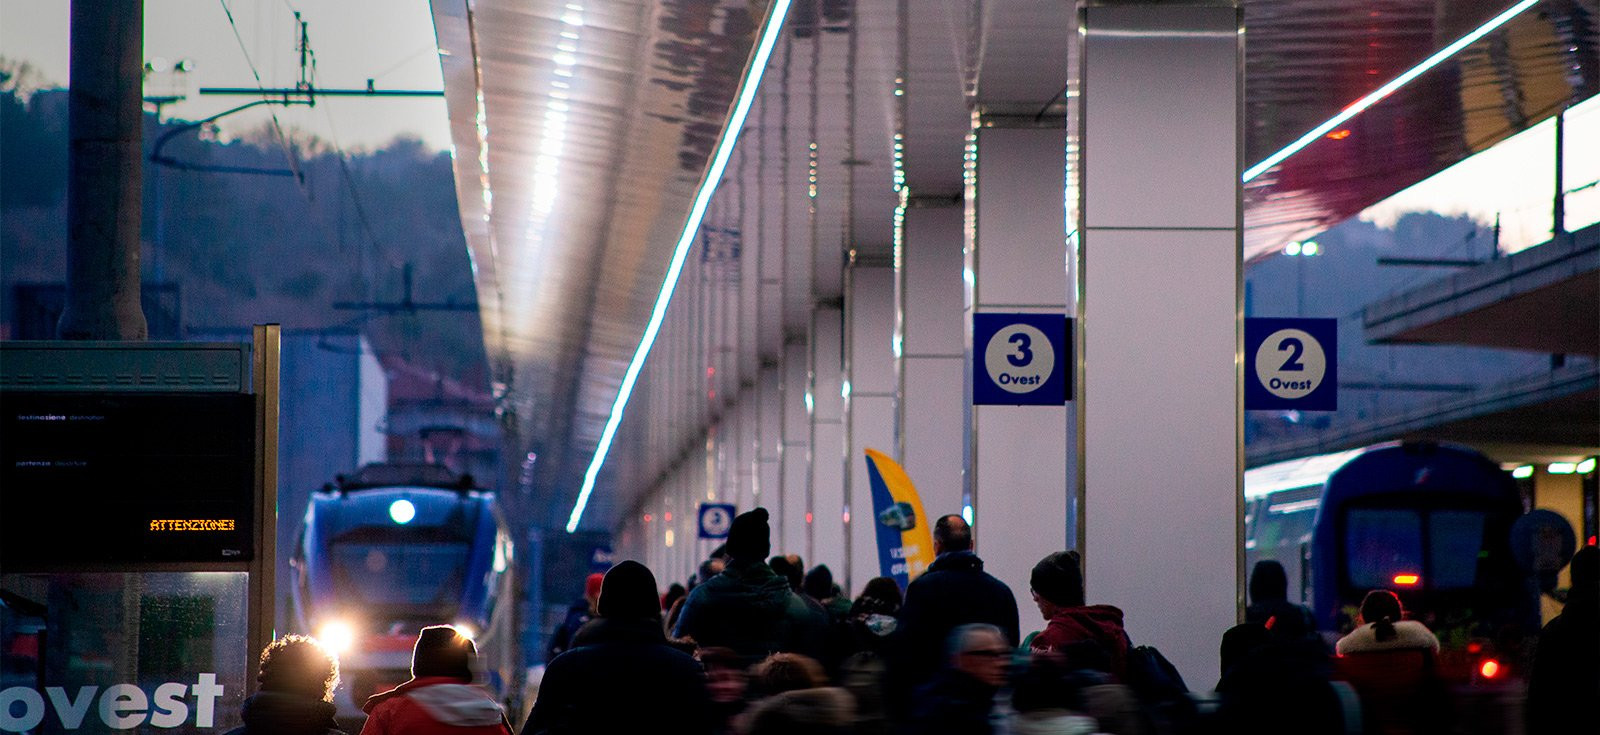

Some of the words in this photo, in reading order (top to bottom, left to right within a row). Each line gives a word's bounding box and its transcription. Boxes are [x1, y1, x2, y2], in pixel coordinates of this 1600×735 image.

[1007, 332, 1033, 367] 3
[1278, 337, 1304, 371] 2
[999, 373, 1040, 385] Ovest
[1269, 378, 1312, 390] Ovest
[0, 673, 224, 732] ovest
